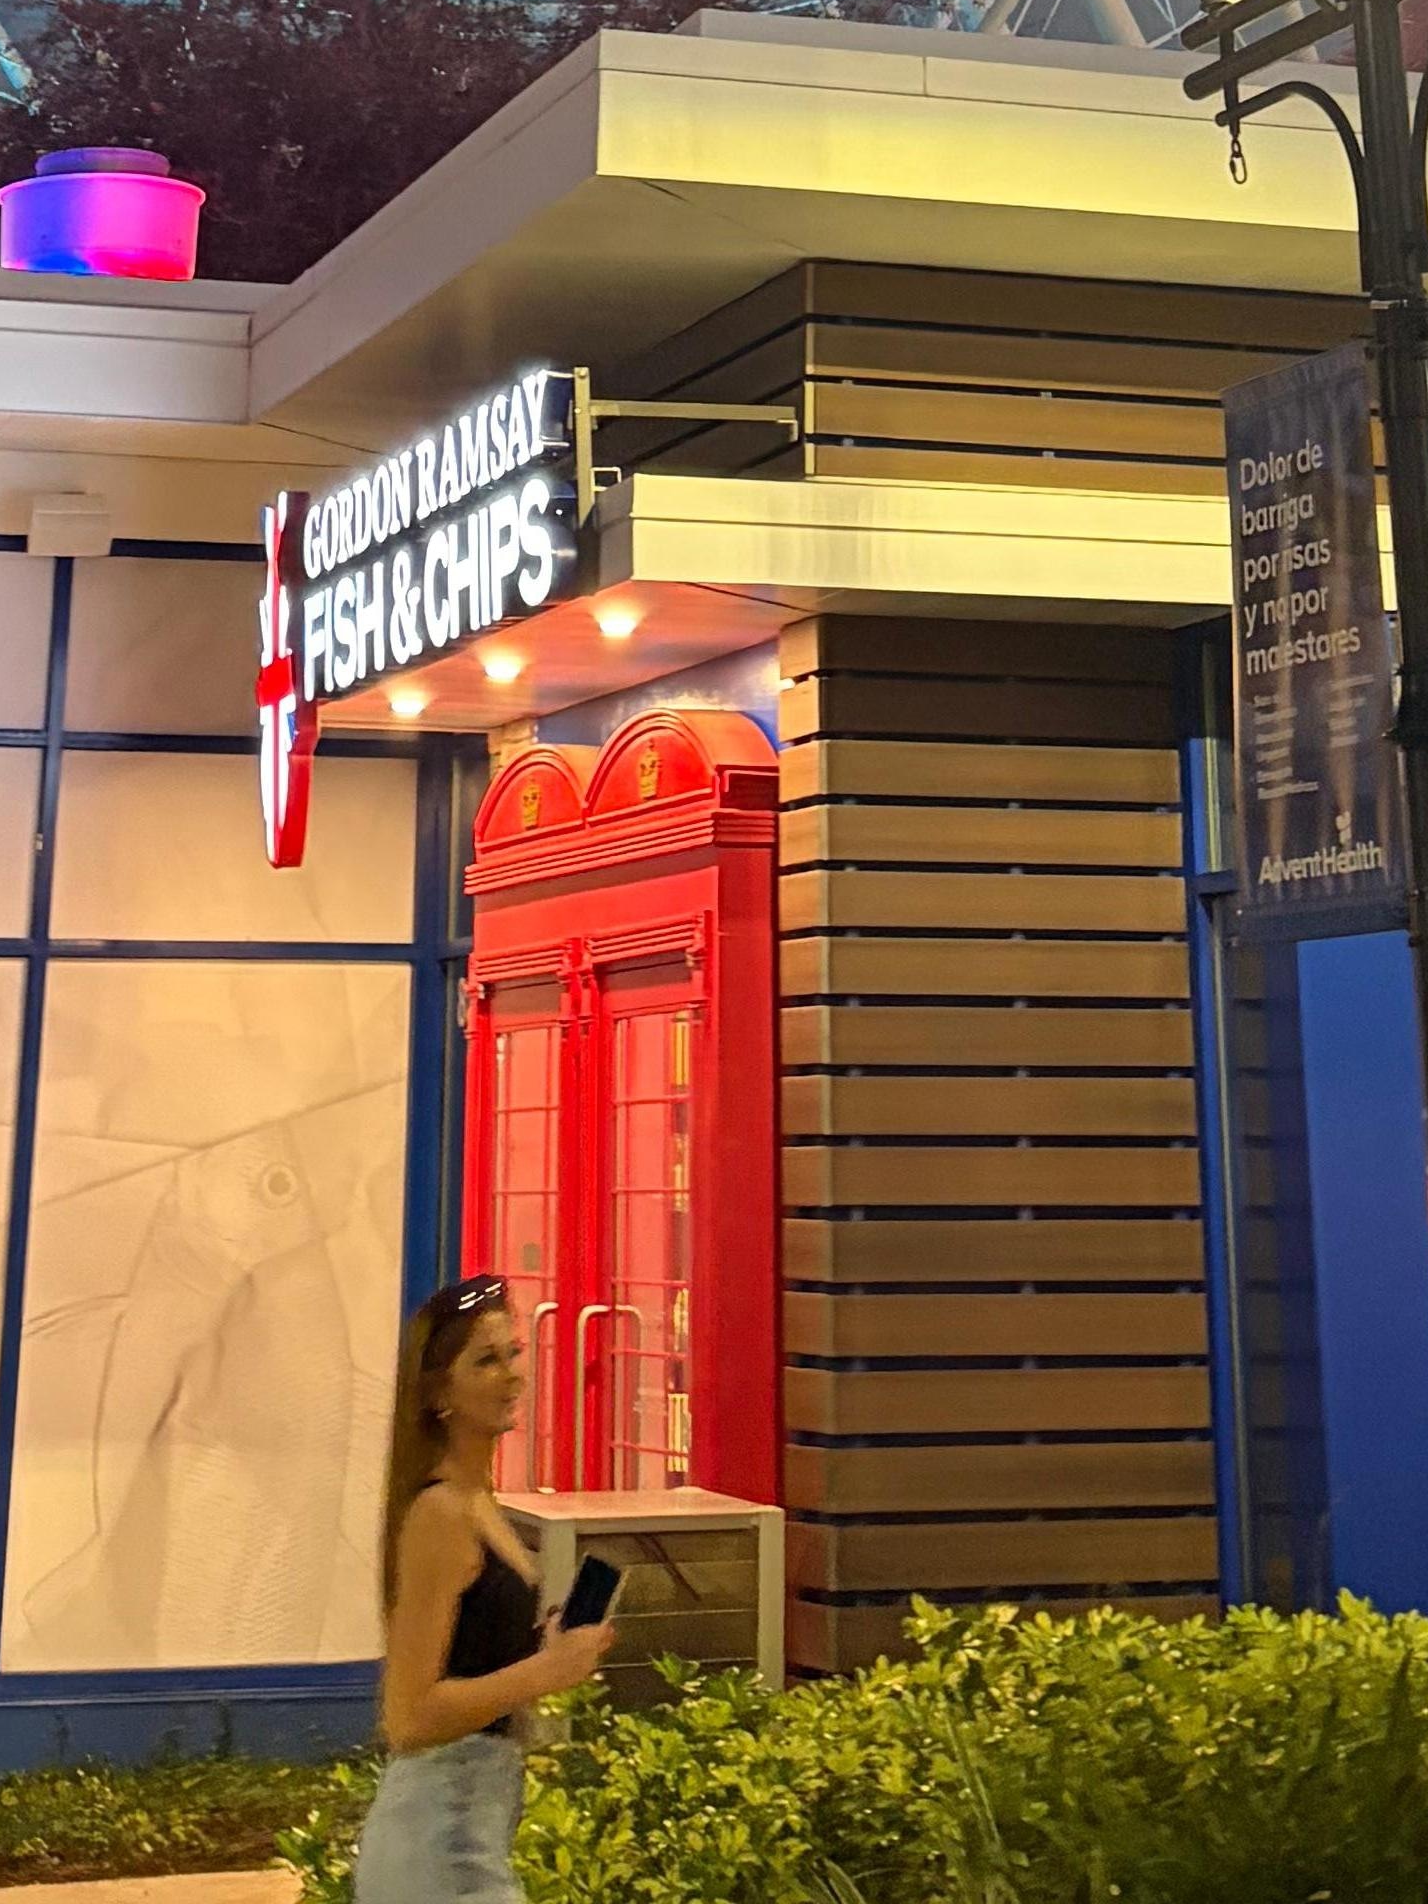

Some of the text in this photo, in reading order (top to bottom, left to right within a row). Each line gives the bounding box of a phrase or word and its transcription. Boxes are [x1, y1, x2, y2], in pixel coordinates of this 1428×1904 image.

[303, 370, 548, 580] GORDON RAMSAY
[1240, 439, 1323, 491] Dolor de
[1241, 493, 1315, 536] barriga
[303, 479, 553, 702] FISH & CHIPS
[1243, 552, 1280, 592] por
[1244, 603, 1258, 638] y
[1290, 586, 1329, 626] por
[1246, 626, 1361, 675] maestares
[1258, 840, 1383, 884] AdventHealth
